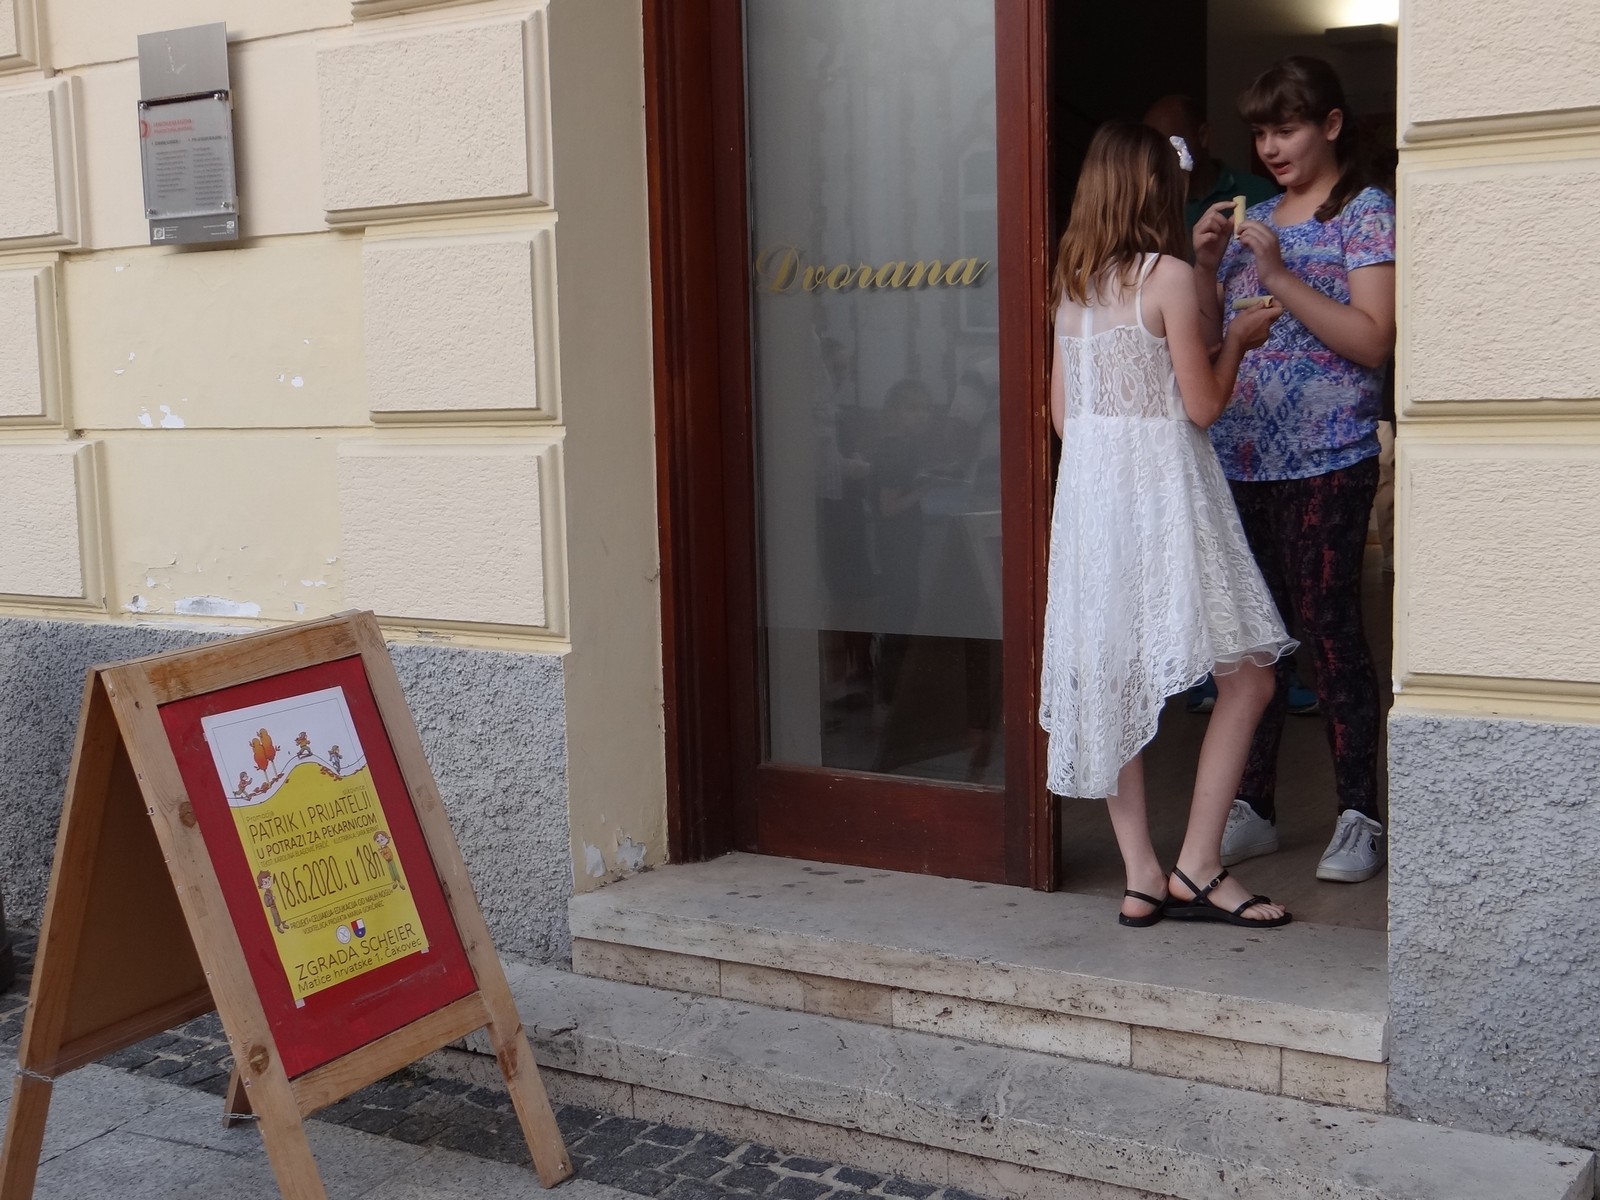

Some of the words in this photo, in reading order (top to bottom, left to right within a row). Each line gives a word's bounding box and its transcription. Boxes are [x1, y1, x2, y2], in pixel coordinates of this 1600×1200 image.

[756, 244, 991, 292] Dvorana
[249, 812, 299, 843] PATRIK
[299, 810, 307, 828] I
[307, 791, 372, 824] PRIJATELJI
[257, 848, 265, 859] U
[266, 835, 307, 857] POTRAZI
[307, 831, 321, 844] ZA
[321, 813, 378, 839] PEKARNICOM
[273, 855, 348, 911] 18.6.2020.
[345, 858, 360, 885] u
[356, 842, 385, 882] 18h
[295, 945, 360, 981] ZGRADA
[360, 923, 416, 956] SCHEIER
[297, 973, 331, 993] Matice
[334, 956, 373, 979] hrvatske
[384, 938, 422, 959] Čakovec
